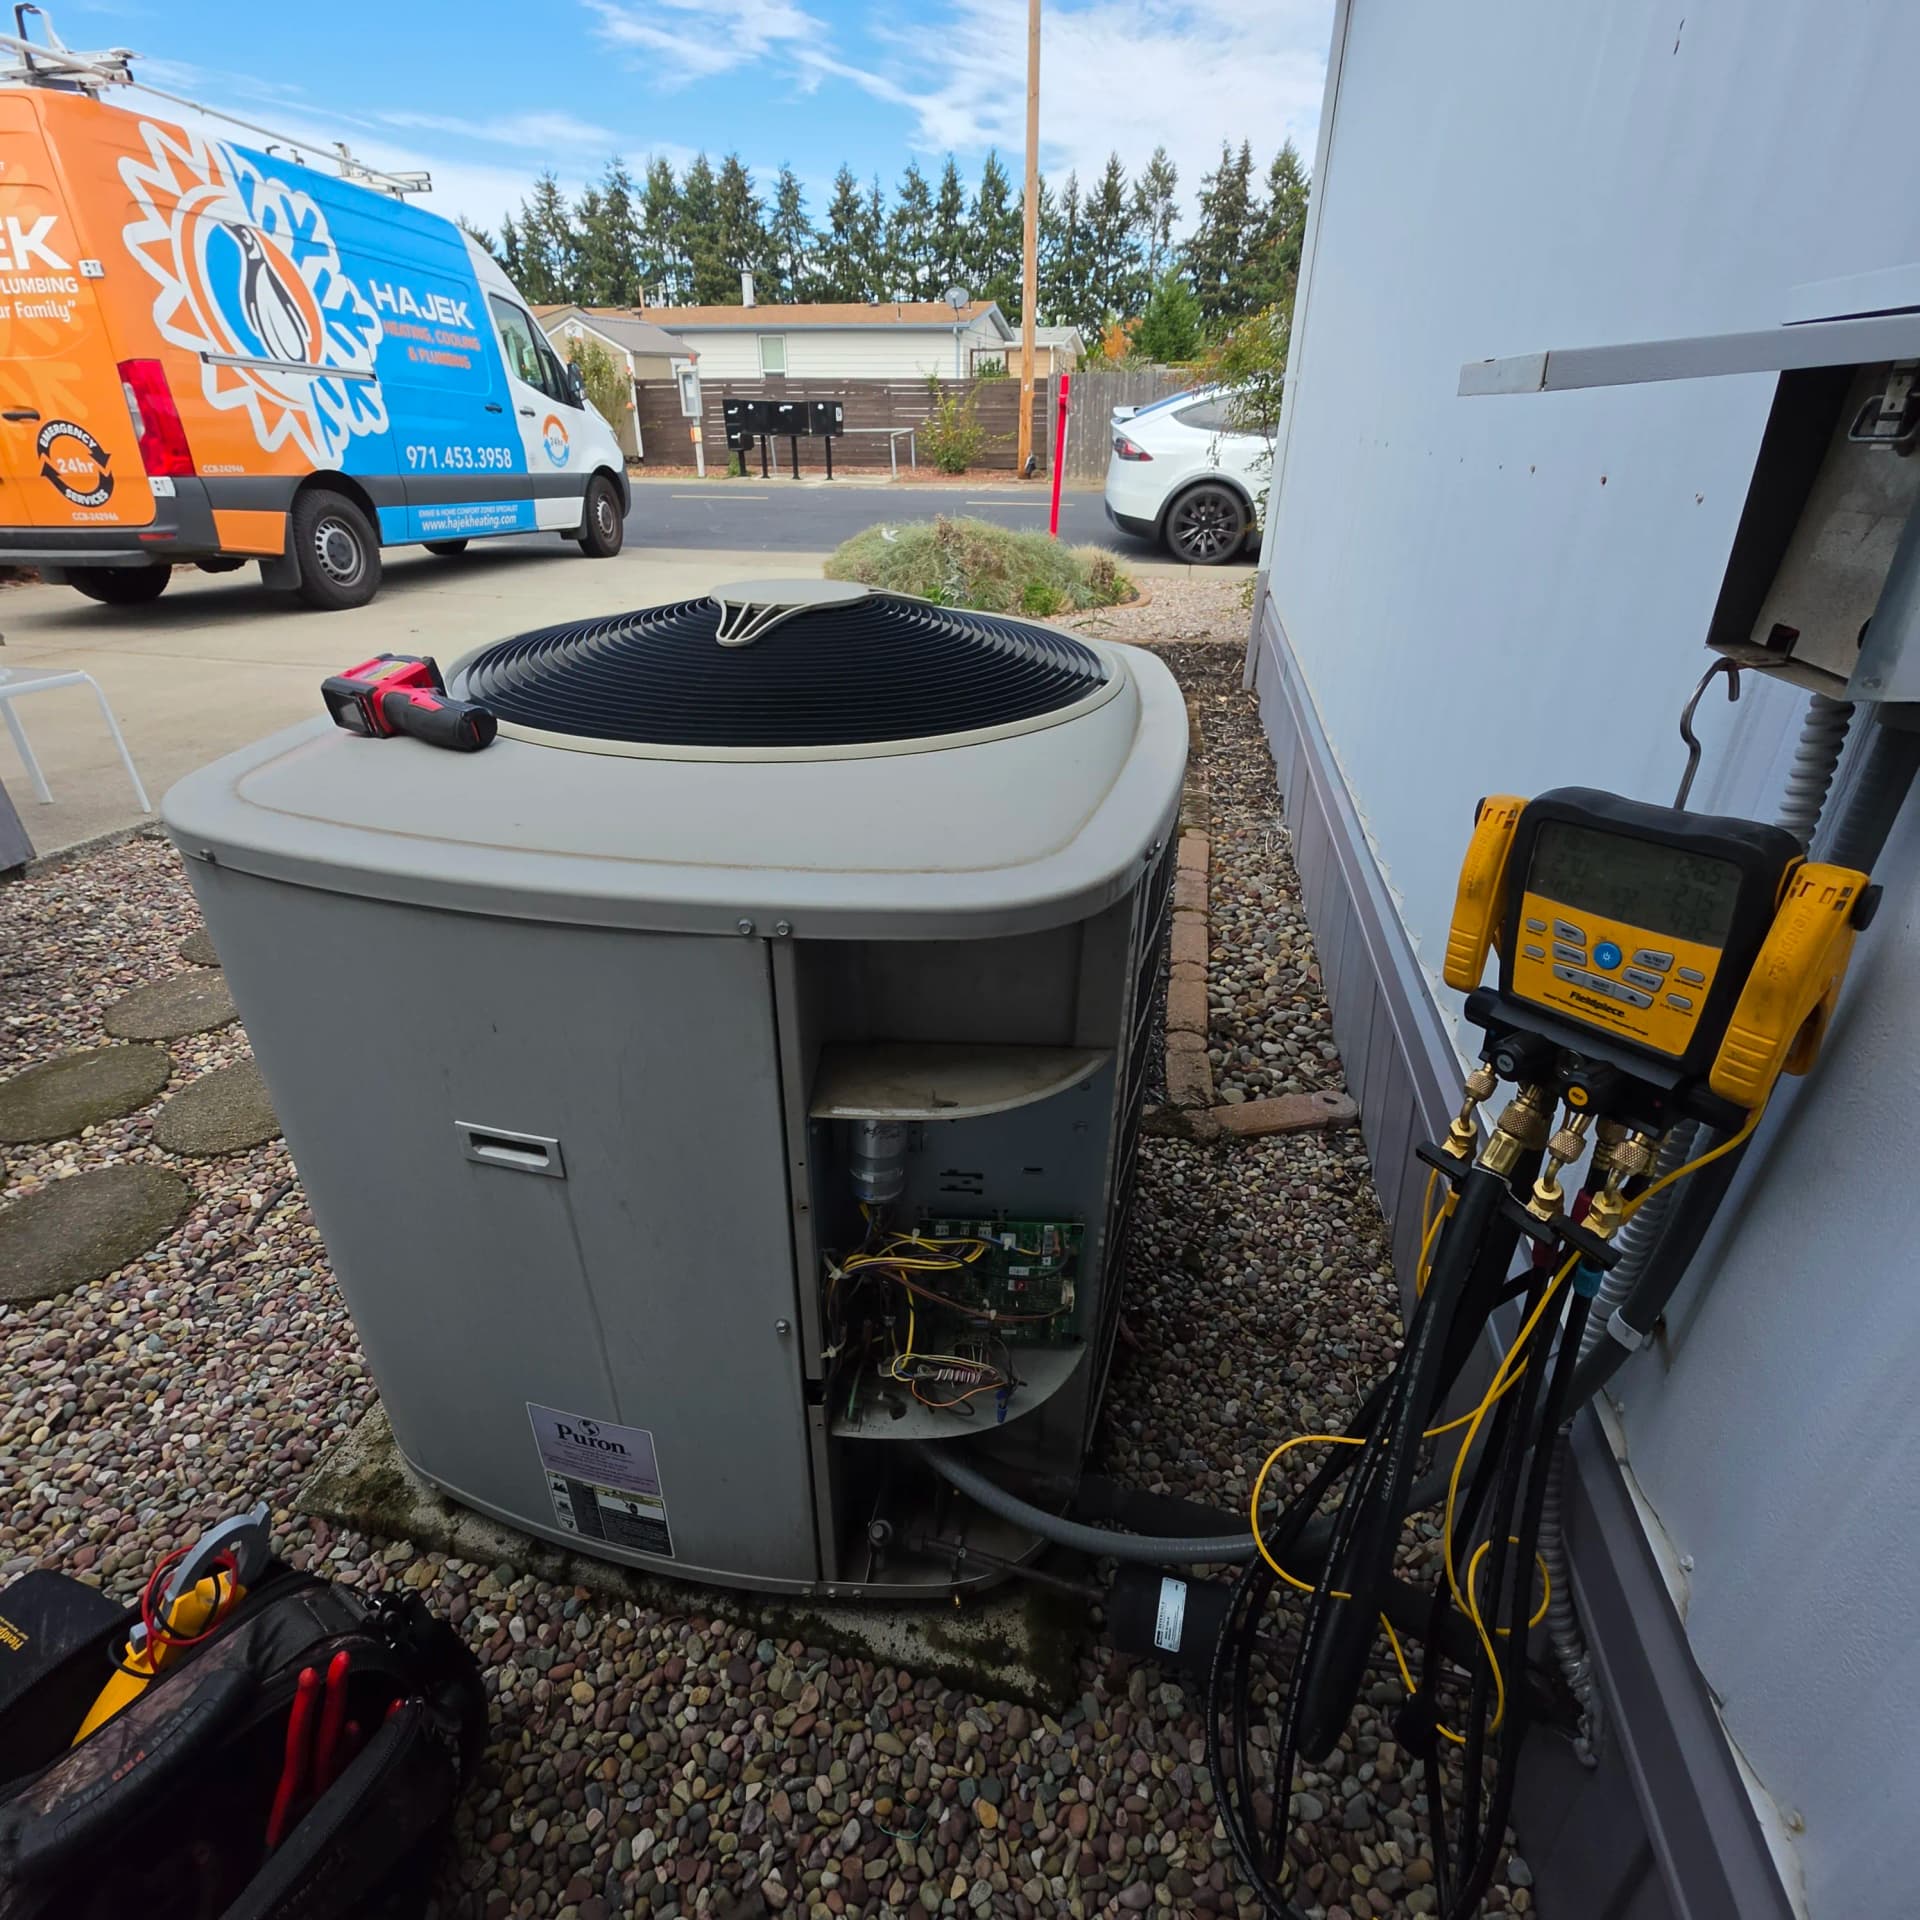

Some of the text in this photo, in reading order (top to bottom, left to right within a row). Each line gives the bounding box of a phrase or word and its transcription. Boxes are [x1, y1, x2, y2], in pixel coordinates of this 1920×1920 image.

[0, 276, 79, 294] LUMBING
[369, 279, 476, 330] HAJEK
[40, 423, 97, 448] EMERGENCY
[57, 458, 95, 473] 24hr
[406, 445, 512, 469] 971.453.3958
[65, 489, 109, 505] SERVICES
[421, 514, 517, 532] www.hajekheating.com
[1570, 991, 1626, 1018] Fieldpiece
[554, 1421, 626, 1455] Puron
